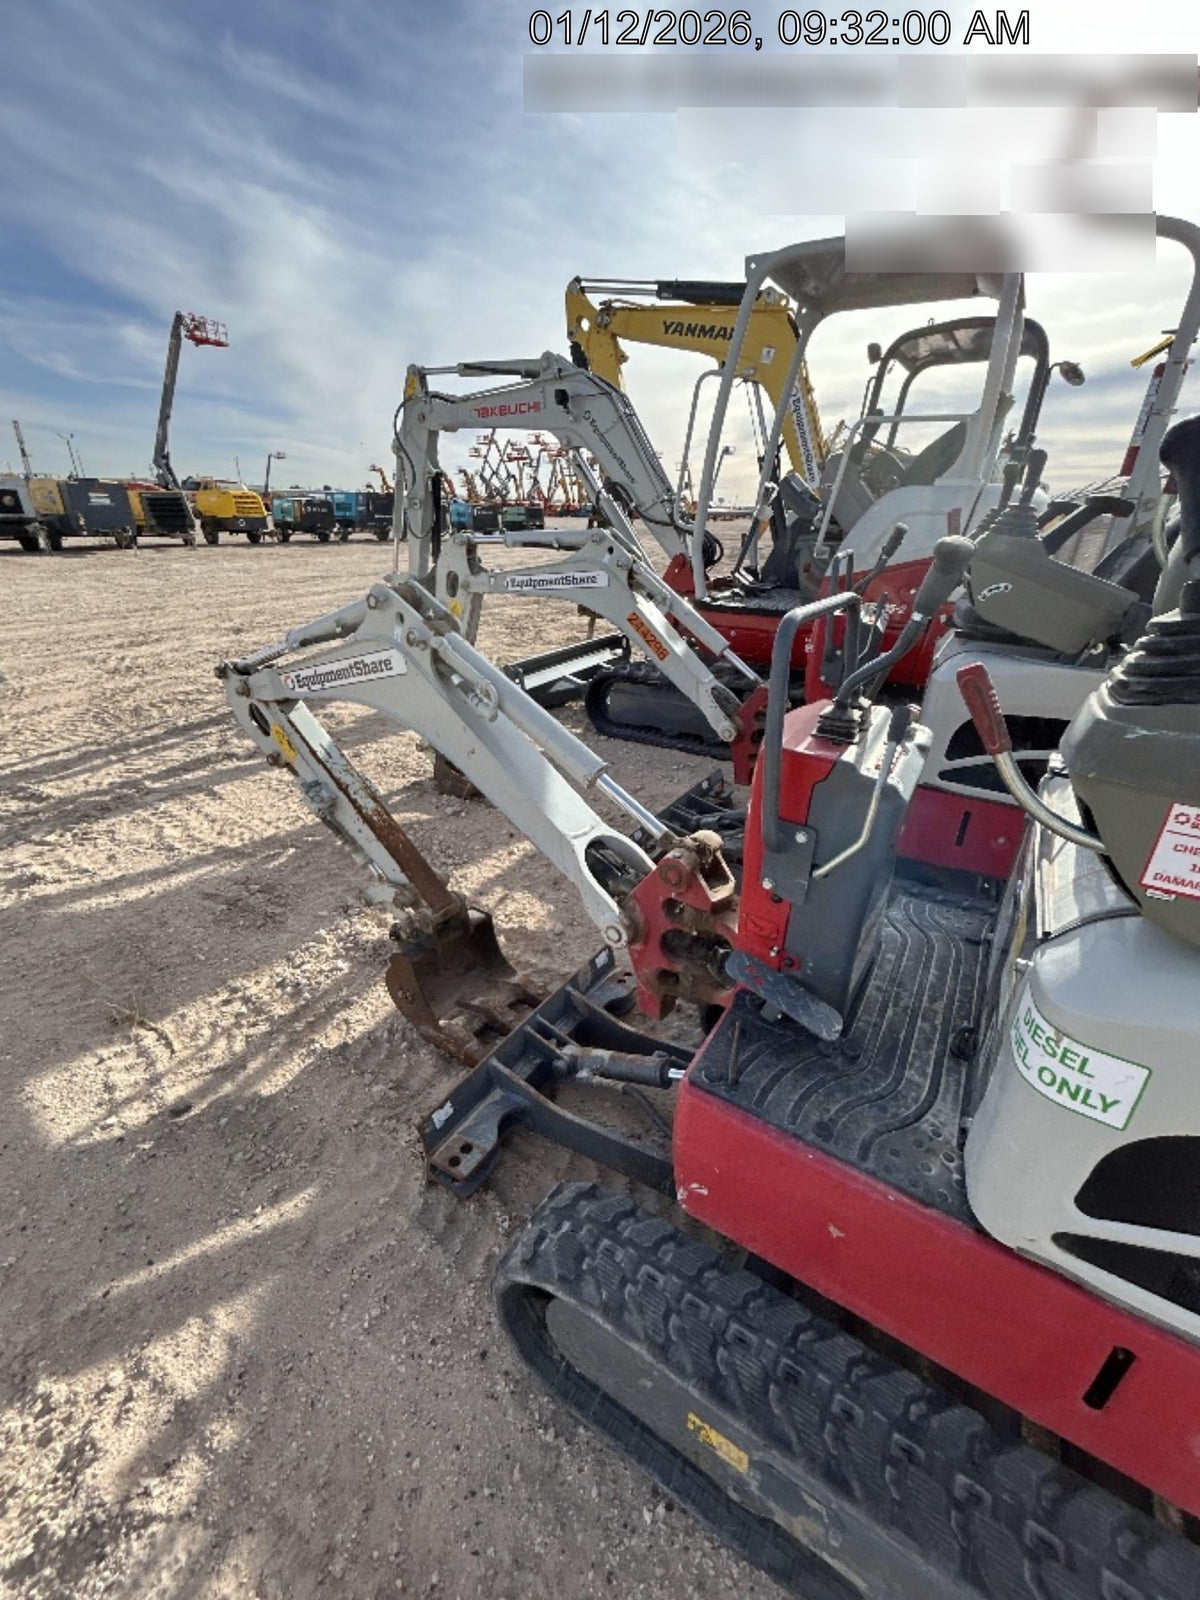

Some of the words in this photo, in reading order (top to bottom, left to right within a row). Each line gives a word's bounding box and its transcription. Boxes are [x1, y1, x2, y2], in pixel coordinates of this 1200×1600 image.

[663, 320, 735, 341] YANMA
[473, 401, 541, 418] TAKEUCHI
[510, 574, 598, 589] EquipmentShare
[294, 657, 393, 690] EquipmentShare
[1023, 1007, 1095, 1078] DIESEL
[1037, 1066, 1121, 1113] ONLY
